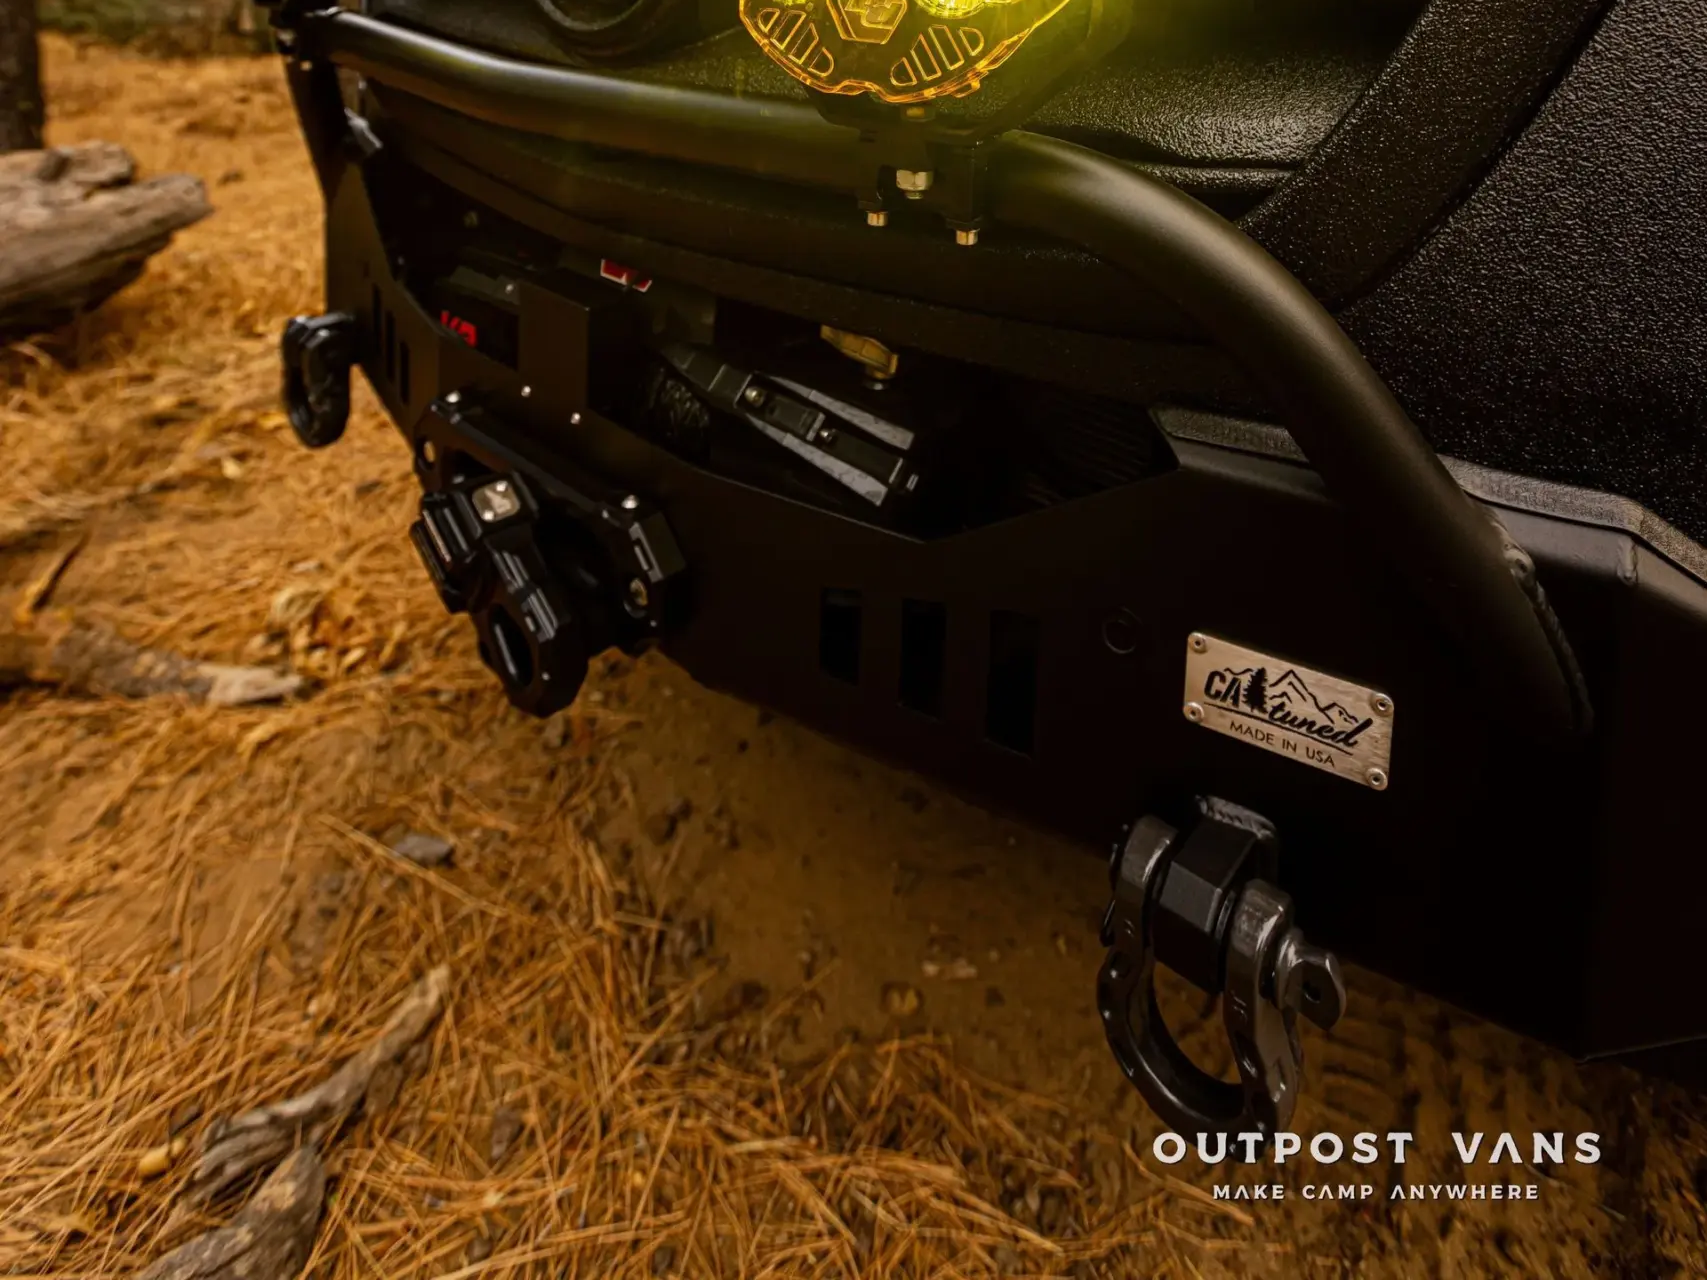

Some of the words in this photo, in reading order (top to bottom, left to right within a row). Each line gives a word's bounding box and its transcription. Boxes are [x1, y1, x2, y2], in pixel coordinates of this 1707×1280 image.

[1229, 721, 1275, 746] MADE
[1282, 738, 1298, 754] IN
[1305, 746, 1336, 768] USA
